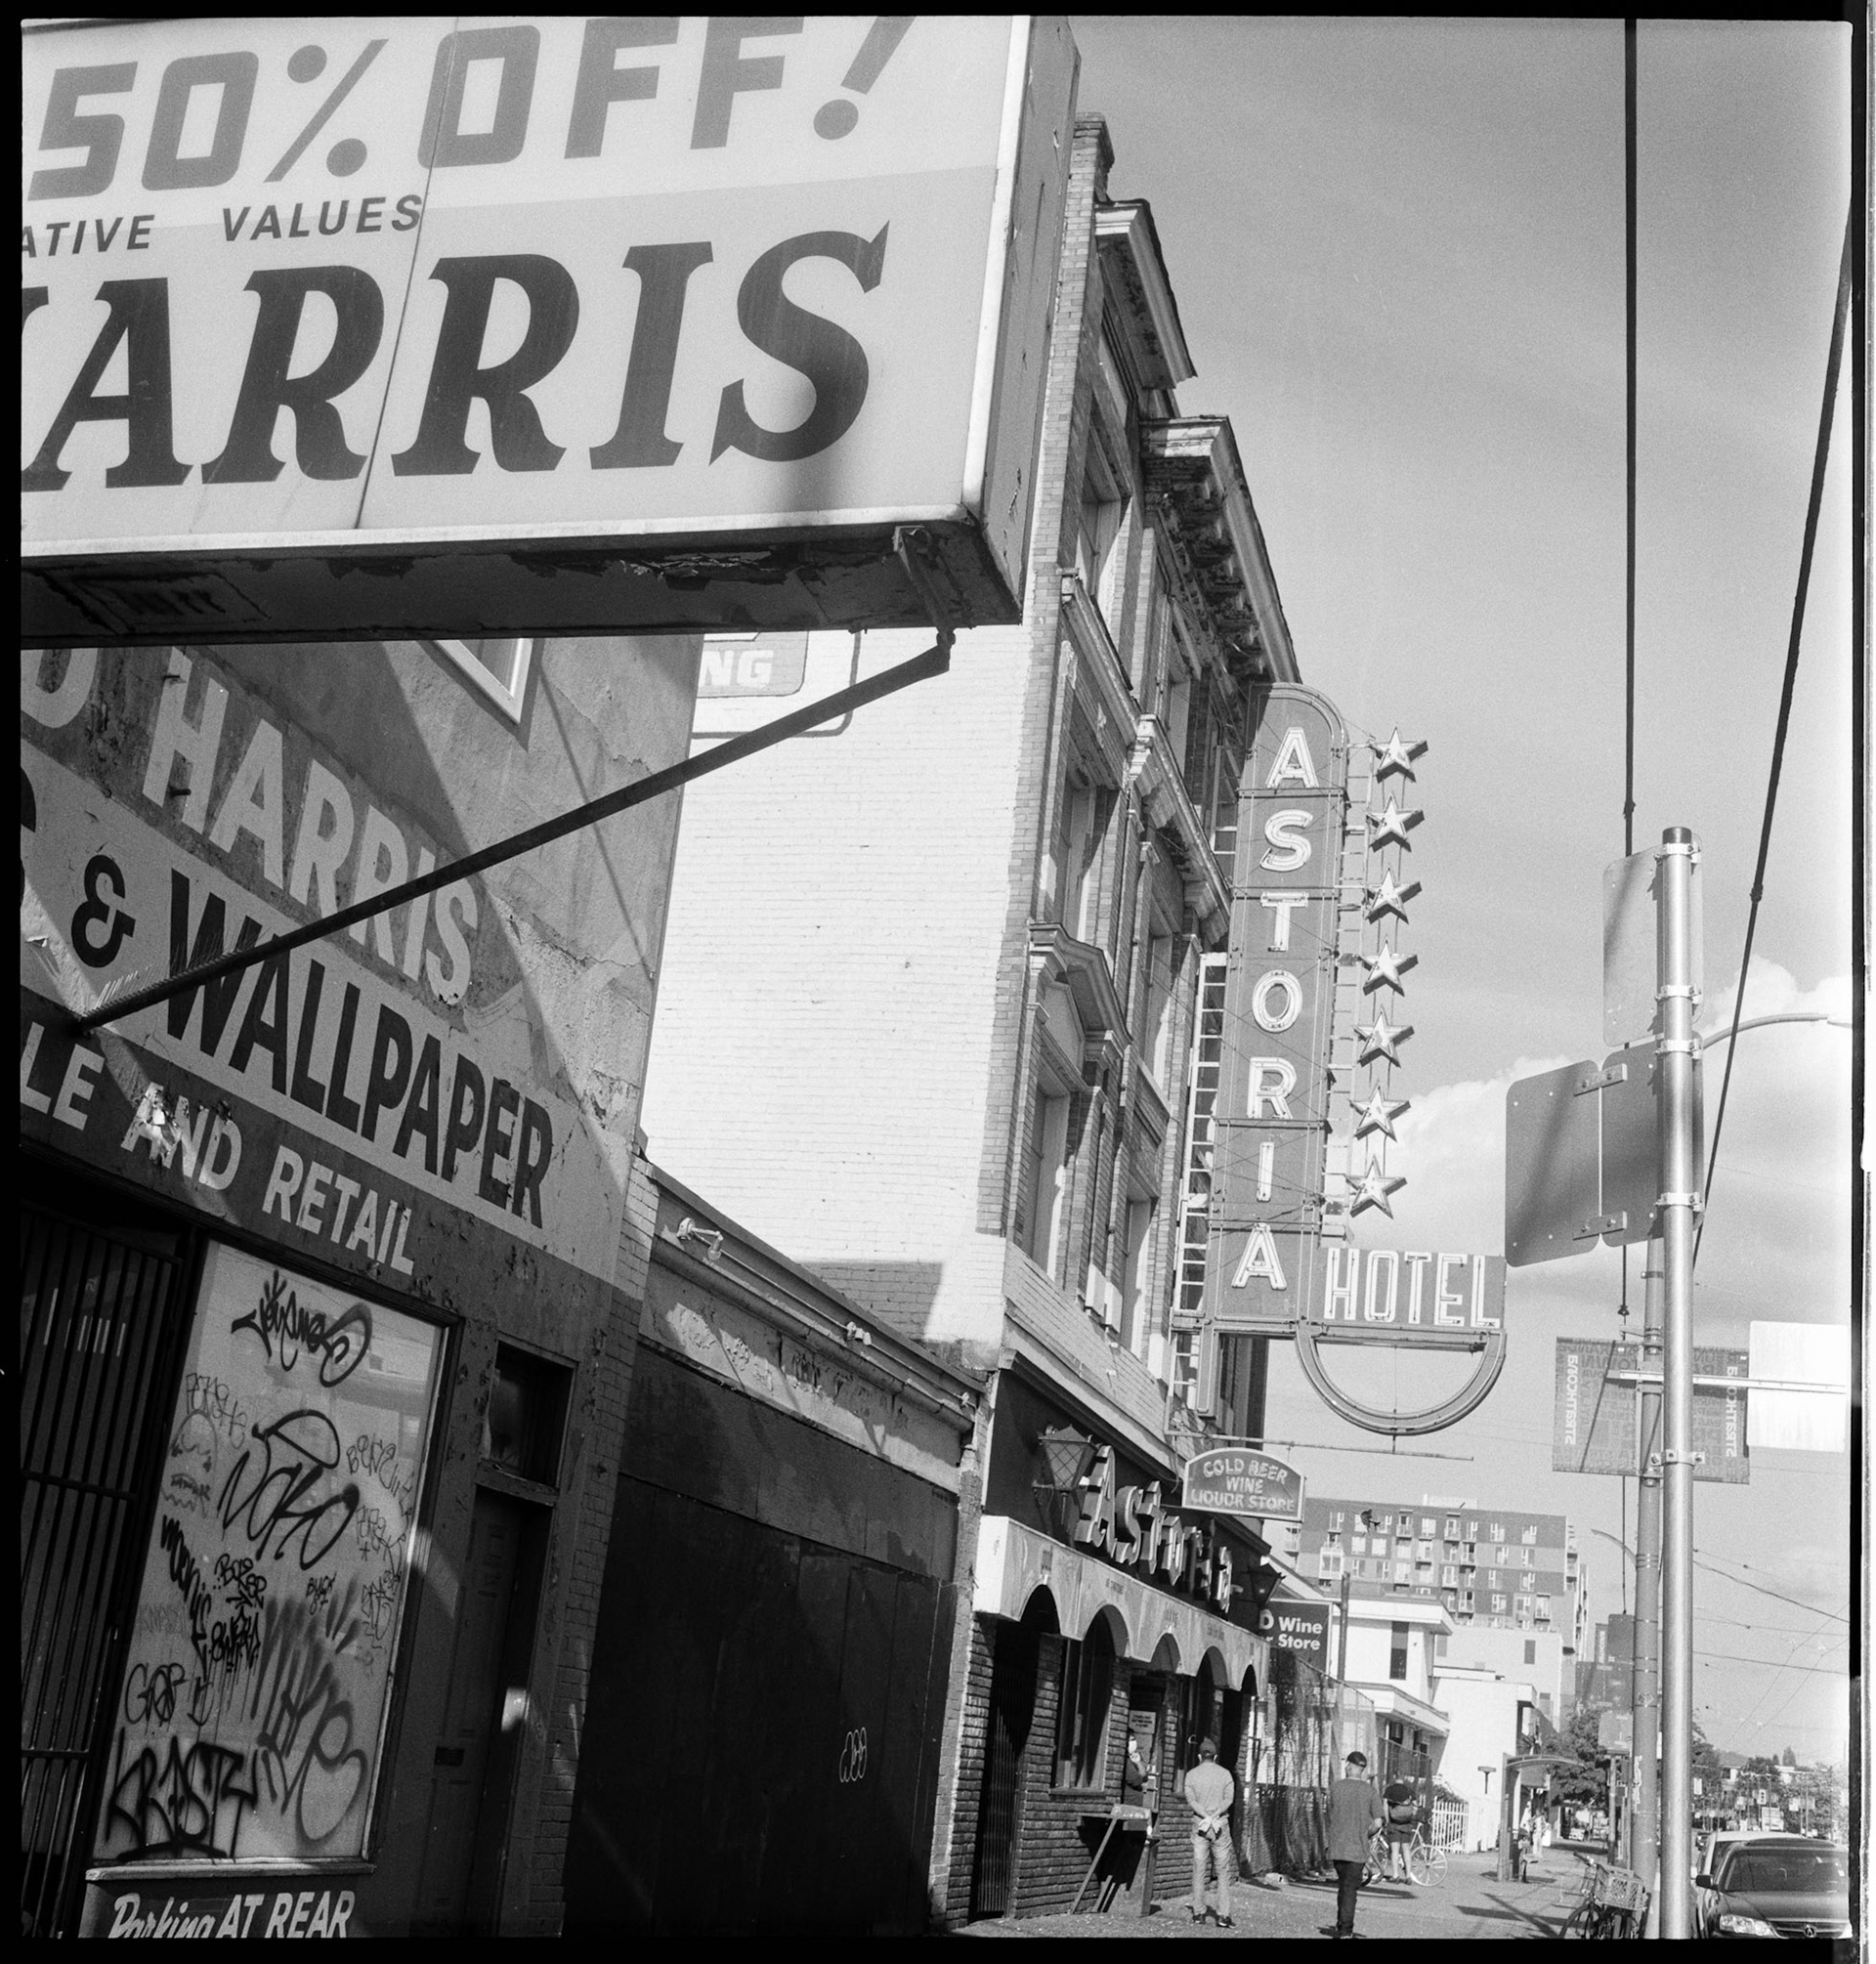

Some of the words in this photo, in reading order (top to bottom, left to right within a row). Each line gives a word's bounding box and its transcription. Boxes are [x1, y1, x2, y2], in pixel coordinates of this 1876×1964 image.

[27, 39, 389, 201] 50%
[417, 17, 917, 170] OFF!
[222, 194, 424, 242] VALUES
[21, 220, 890, 492] ARRIS
[142, 646, 478, 1005] HARRIS
[1231, 726, 1319, 1291] ASTORIA
[71, 855, 136, 967] &
[166, 868, 552, 1228] WALLPAPER
[120, 1082, 242, 1190] AND
[262, 1144, 415, 1275] RETAIL
[1323, 1248, 1501, 1329] HOTEL
[1191, 1488, 1244, 1509] LIQUOR
[1249, 1495, 1295, 1513] STORE
[1203, 1458, 1245, 1477] COLD
[1248, 1460, 1288, 1484] BEER
[1225, 1476, 1264, 1494] WINE
[1278, 1616, 1323, 1635] Wine
[1278, 1633, 1321, 1650] Store
[216, 1894, 265, 1939] AT
[264, 1891, 356, 1939] REAR
